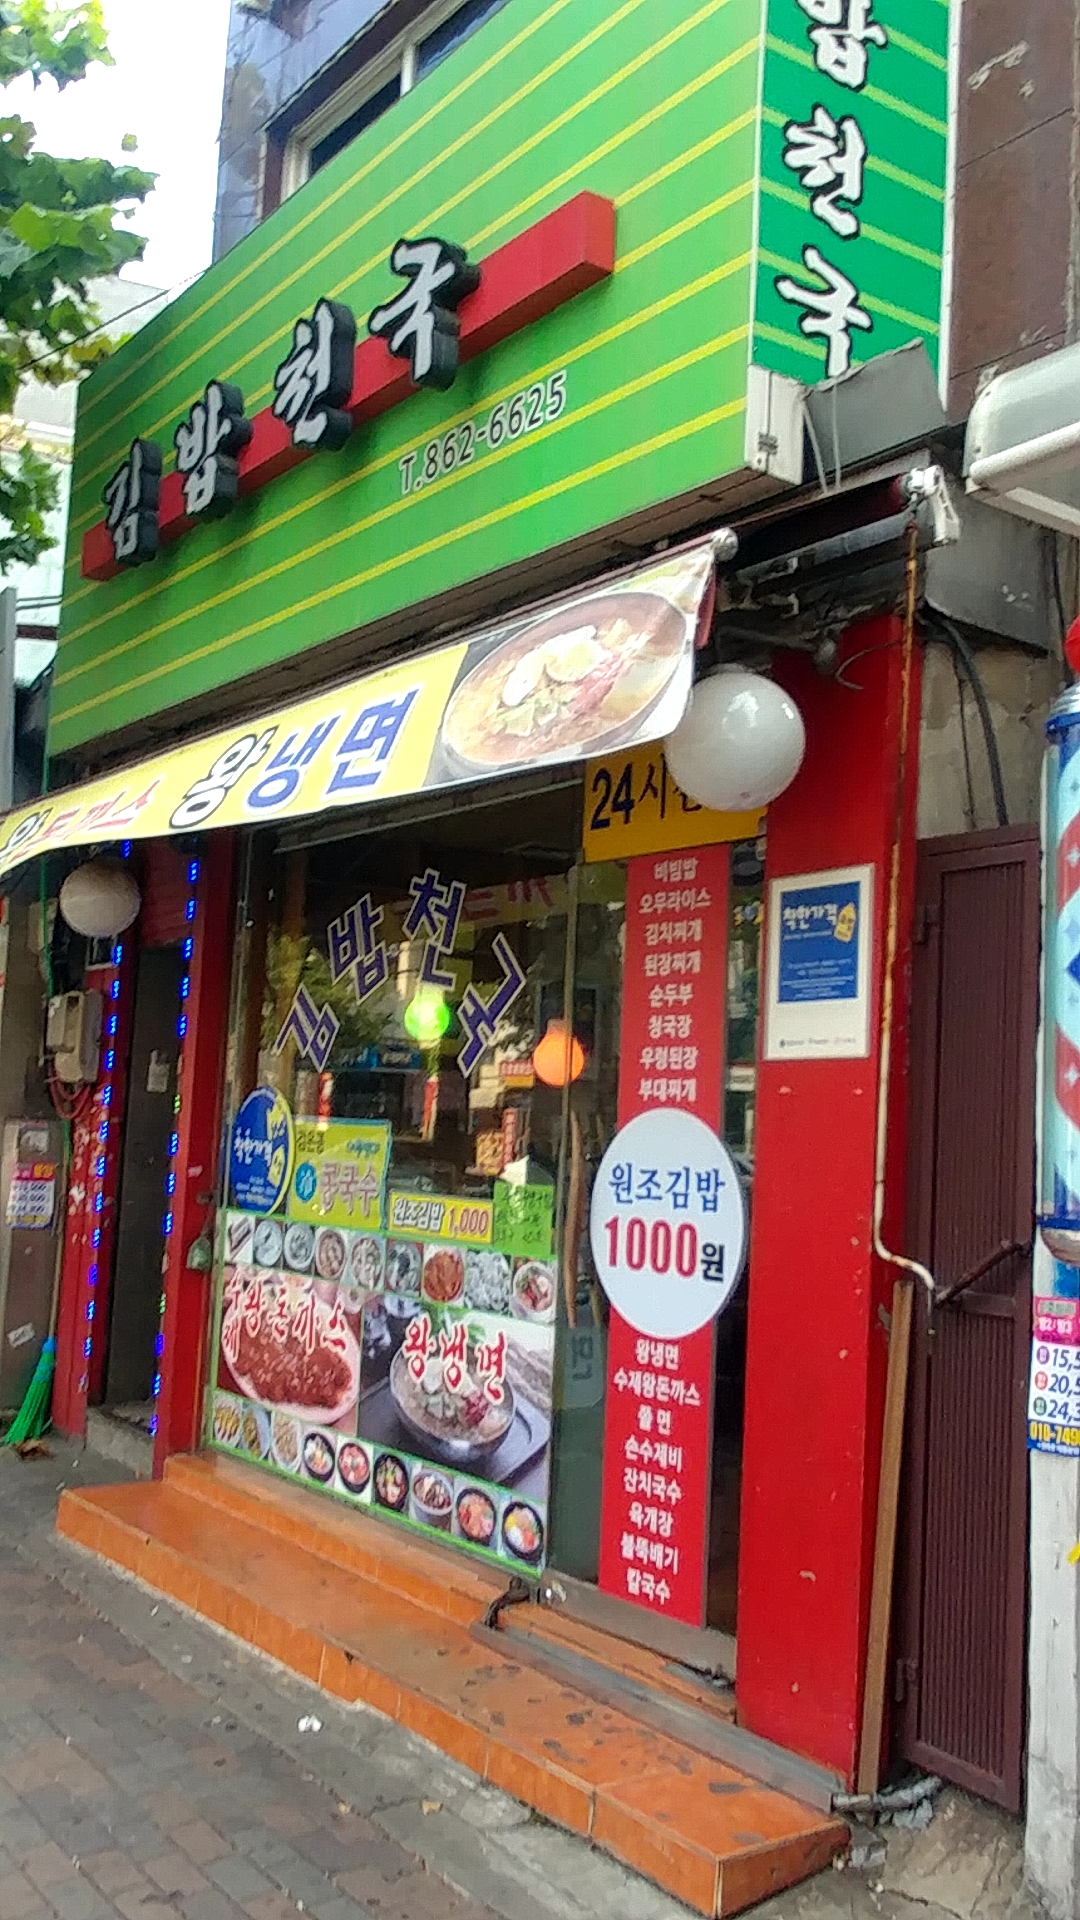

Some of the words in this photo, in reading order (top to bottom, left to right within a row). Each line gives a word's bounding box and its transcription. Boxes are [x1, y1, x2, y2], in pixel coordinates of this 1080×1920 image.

[103, 236, 464, 566] 김밥천국
[399, 370, 567, 494] T.862-6625
[169, 687, 420, 829] 왕냉면
[638, 887, 712, 914] 오무라이스
[272, 868, 527, 1079] 김밥천국
[648, 983, 694, 1008] 순두부
[648, 1014, 693, 1039] 청국장
[639, 1046, 699, 1070] 우렁된장
[321, 1161, 379, 1218] 콩국수
[608, 1162, 726, 1213] 원조김밥
[393, 1197, 446, 1232] 원조김밥
[449, 1205, 489, 1238] 1,000
[403, 1314, 508, 1404] 왕냉면
[636, 1339, 679, 1371] 왕냉면
[613, 1367, 701, 1407] 수제왕돈까스
[623, 1467, 682, 1506] 잔치국수
[626, 1566, 671, 1606] 칼국수
